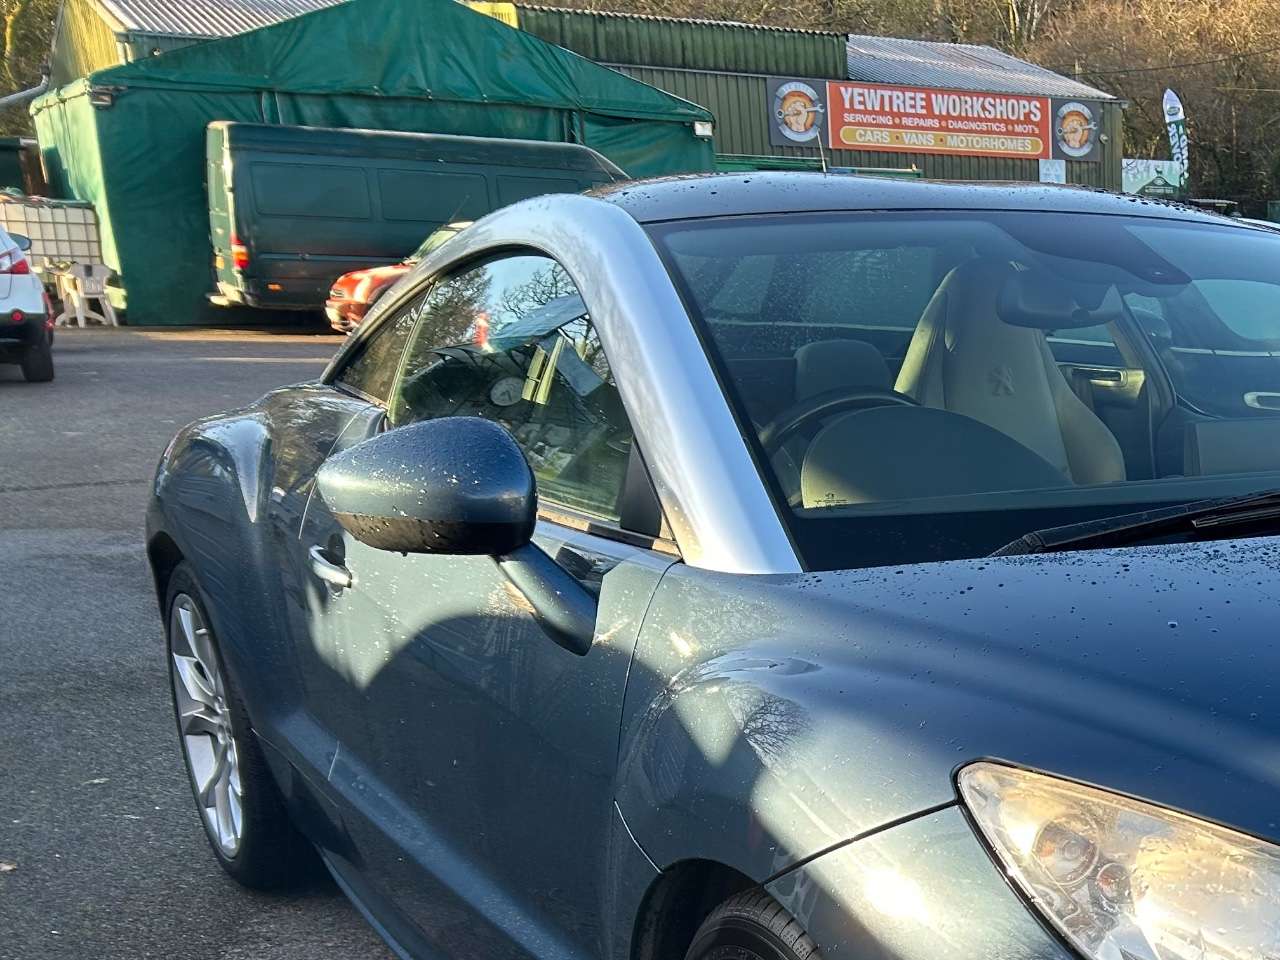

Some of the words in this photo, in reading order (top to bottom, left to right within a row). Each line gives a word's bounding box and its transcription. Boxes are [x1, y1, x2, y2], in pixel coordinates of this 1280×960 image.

[840, 87, 927, 114] YEWTREE
[931, 93, 1042, 121] WORKSHOPS
[843, 113, 893, 125] SERVICING
[902, 117, 940, 128] REPAIRS
[948, 120, 1007, 132] DIAGNOSTICS
[856, 129, 890, 143] CARS
[902, 133, 935, 146] VANS
[947, 136, 1032, 151] MOTORHOMES
